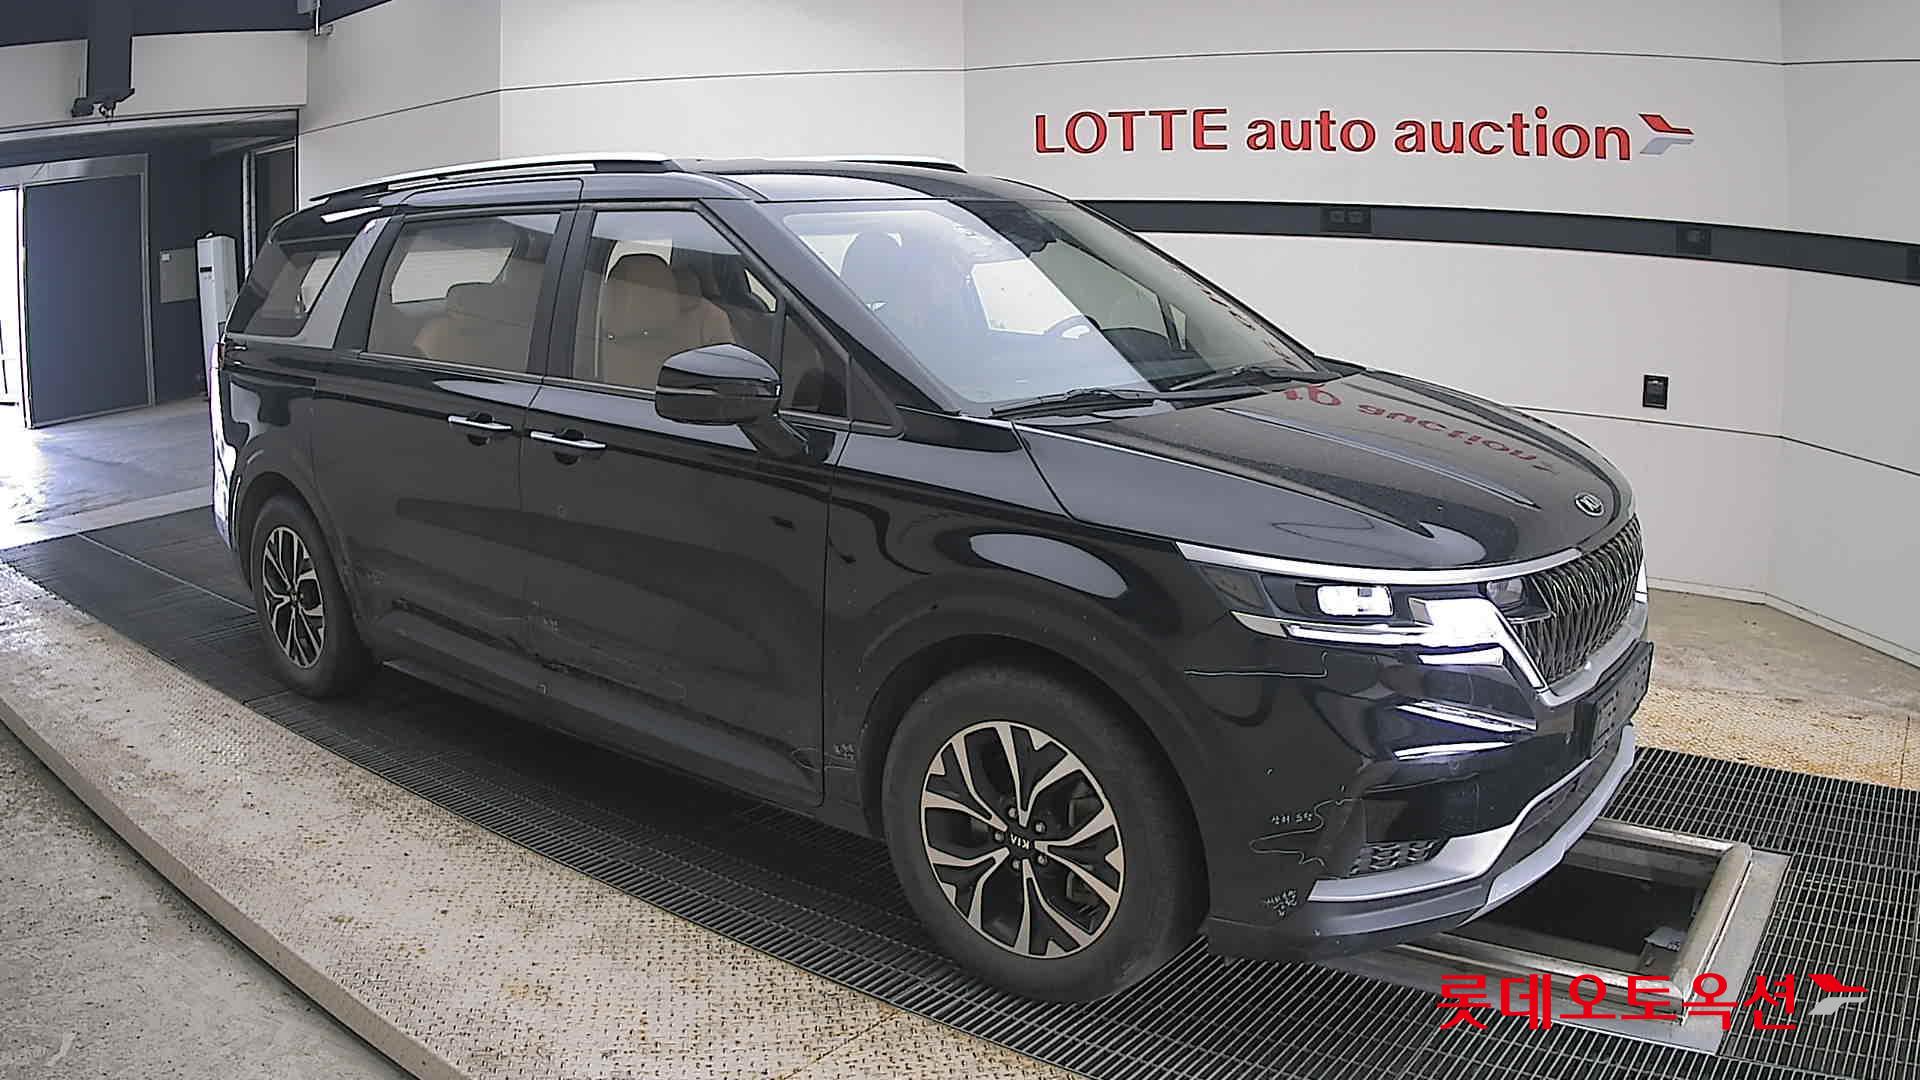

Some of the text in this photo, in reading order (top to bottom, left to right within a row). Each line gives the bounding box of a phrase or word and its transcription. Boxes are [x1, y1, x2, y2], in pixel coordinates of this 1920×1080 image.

[1034, 105, 1632, 161] LOTTE auto auction
